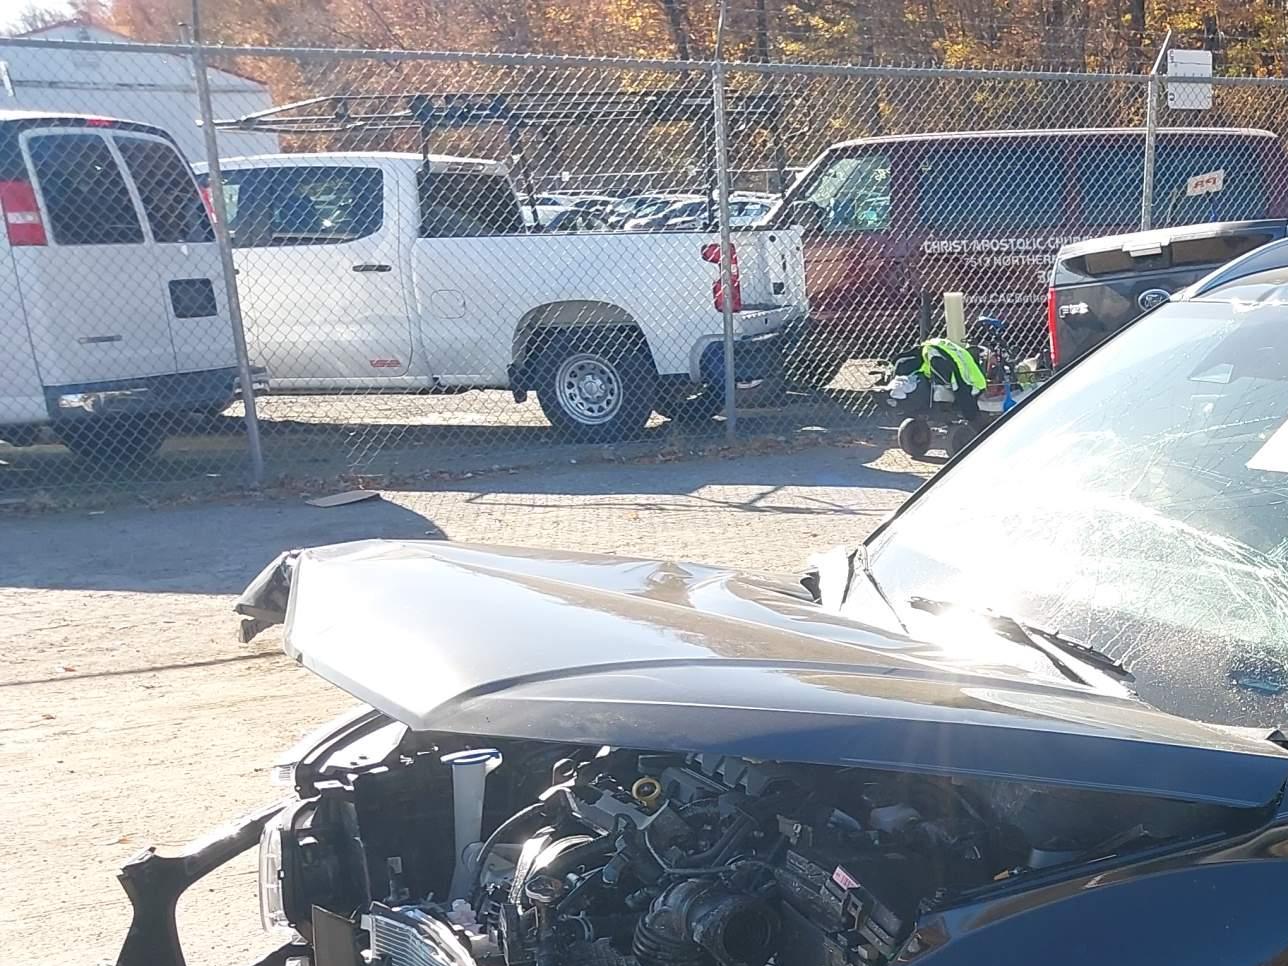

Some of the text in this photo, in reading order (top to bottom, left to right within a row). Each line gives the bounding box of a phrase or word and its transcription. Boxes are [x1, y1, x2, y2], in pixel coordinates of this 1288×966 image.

[924, 236, 1091, 254] CHRIST APOSTOLIC CHUR
